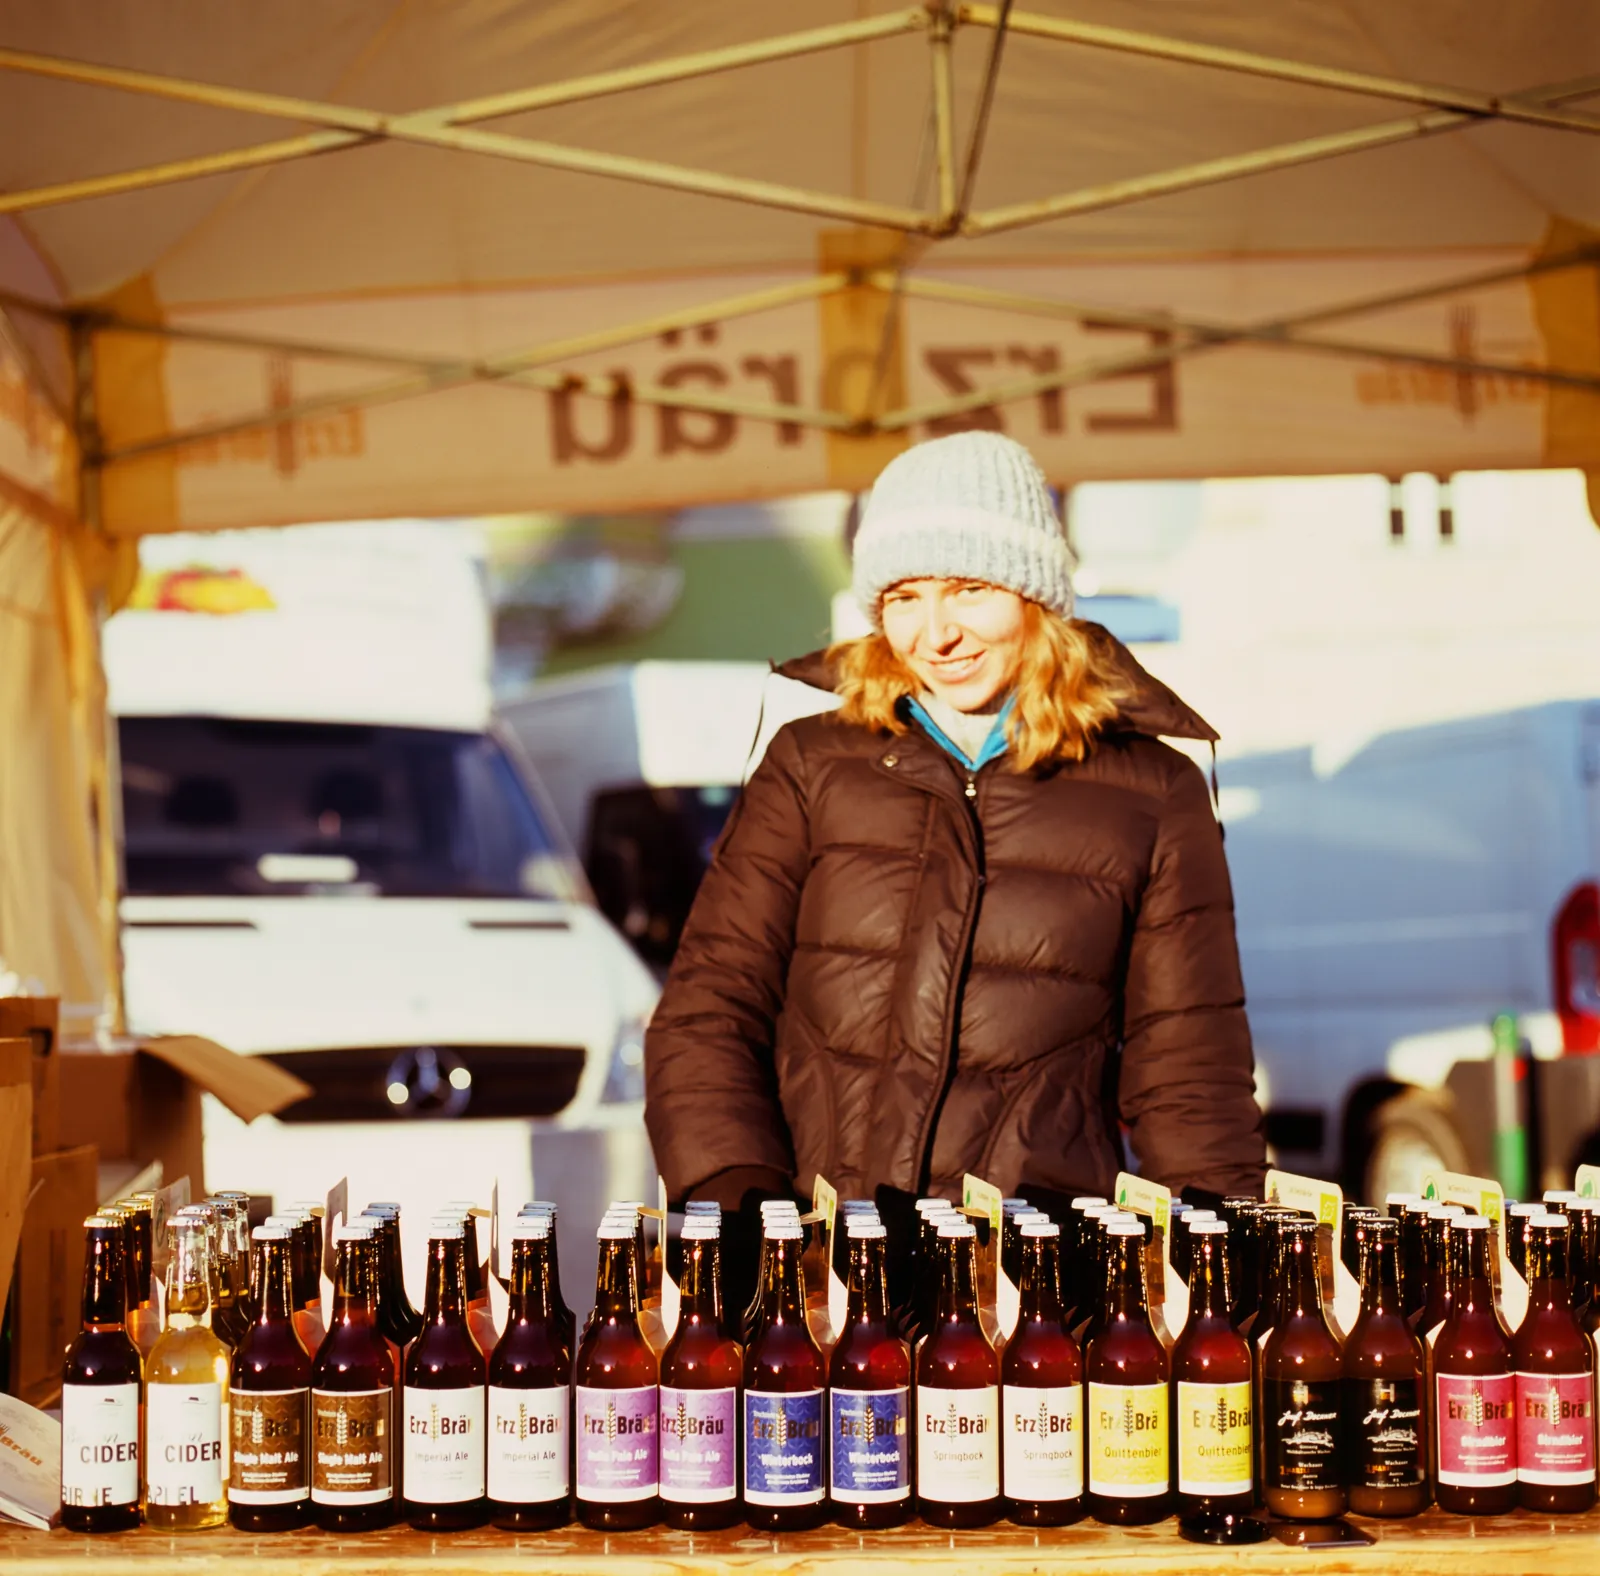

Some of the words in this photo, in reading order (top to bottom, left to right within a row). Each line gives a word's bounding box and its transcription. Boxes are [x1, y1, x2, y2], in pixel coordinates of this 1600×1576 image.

[410, 1415, 428, 1434] Erz
[497, 1415, 515, 1434] Erz
[661, 1412, 676, 1433] Erz
[687, 1415, 724, 1435] Bräu
[753, 1417, 774, 1438] Erz
[841, 1416, 862, 1438] Erz
[926, 1414, 946, 1434] Erz
[1015, 1414, 1036, 1433] Erz
[80, 1442, 138, 1463] CIDER
[164, 1441, 221, 1462] CIDER
[284, 1452, 299, 1463] Ale
[368, 1452, 383, 1464] Ale
[455, 1452, 469, 1460] Ale
[543, 1451, 556, 1460] Ale
[634, 1449, 648, 1461] Ale
[933, 1450, 984, 1461] Springbock
[1024, 1449, 1073, 1461] Springbock
[1104, 1447, 1162, 1459] Quittenbier
